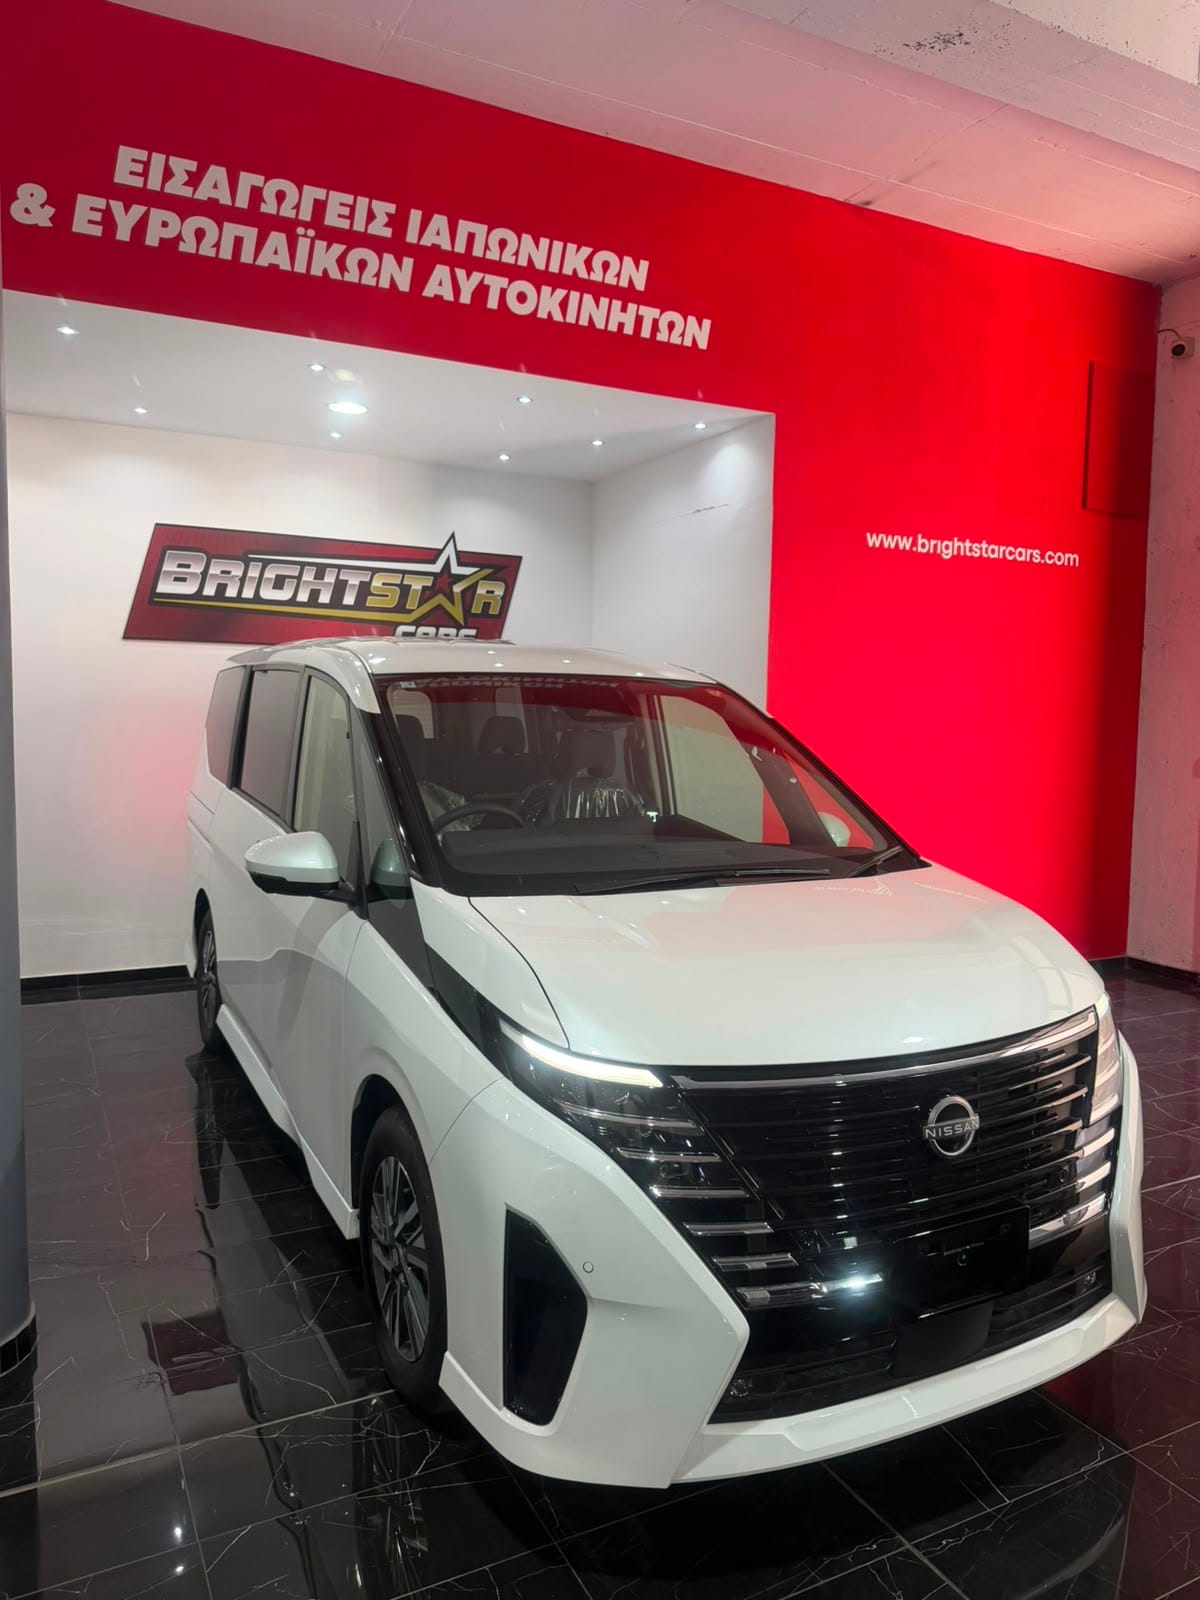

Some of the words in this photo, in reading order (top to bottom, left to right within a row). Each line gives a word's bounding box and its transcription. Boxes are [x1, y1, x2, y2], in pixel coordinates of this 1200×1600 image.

[10, 183, 56, 228] &
[72, 193, 414, 293] ΕΥΡΩΠΑΪΚΩΝ
[422, 264, 712, 350] ΑΥΤΟΚΙΝΗΤΩΝ
[113, 145, 397, 238] ΕΙΣΑΓΩΓΕΙΣ
[405, 208, 649, 292] ΙΑΠΩΝΙΚΩΝ
[866, 532, 1080, 567] www.brightstarcars.com
